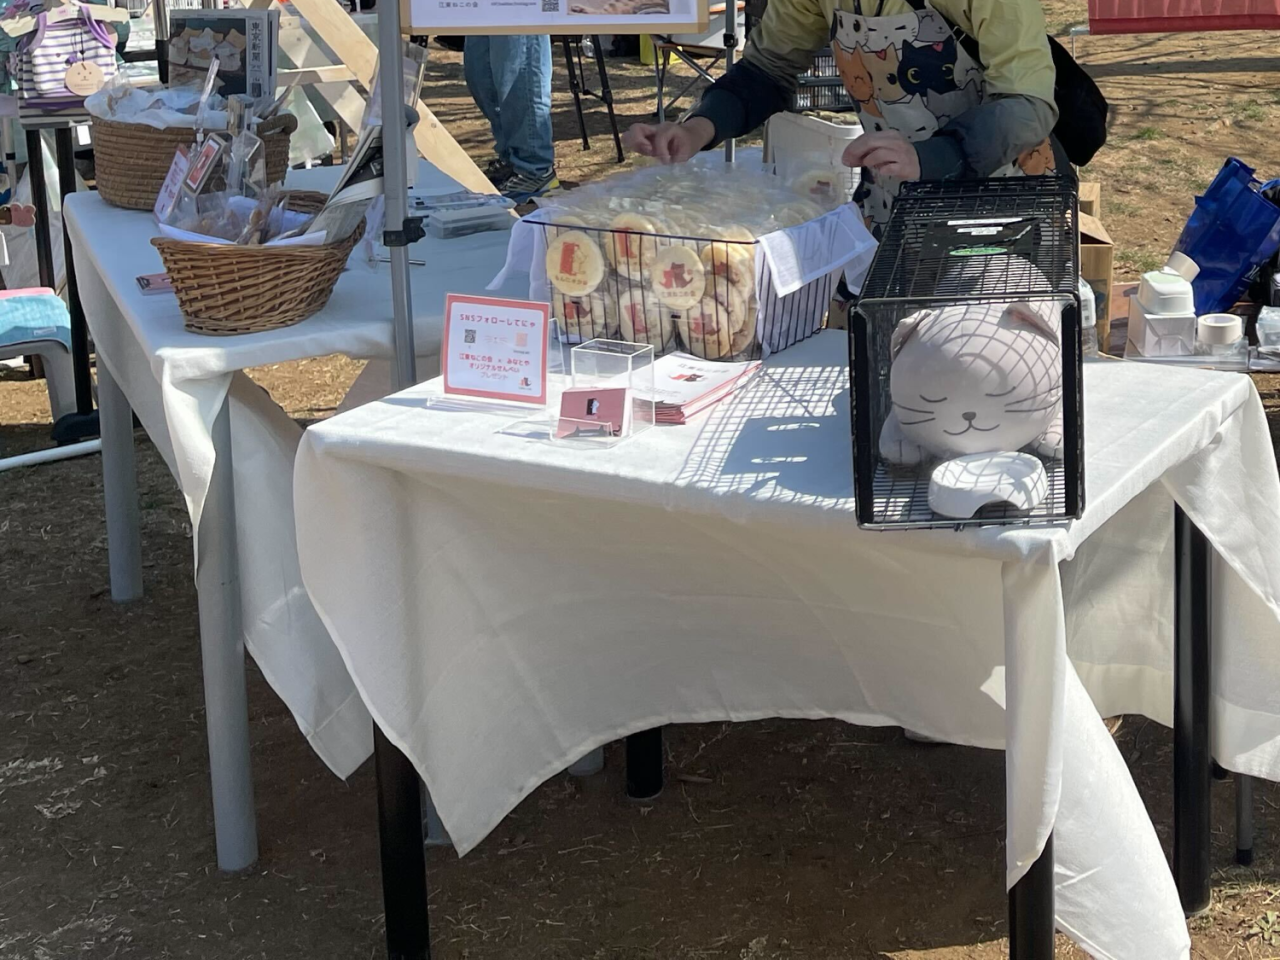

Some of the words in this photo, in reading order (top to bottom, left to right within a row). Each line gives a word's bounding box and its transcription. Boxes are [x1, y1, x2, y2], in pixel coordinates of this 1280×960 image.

[251, 21, 262, 62] 東京新聞
[459, 313, 536, 328] SNSフォローしてにゃ
[469, 362, 520, 373] オリジナルせんべい
